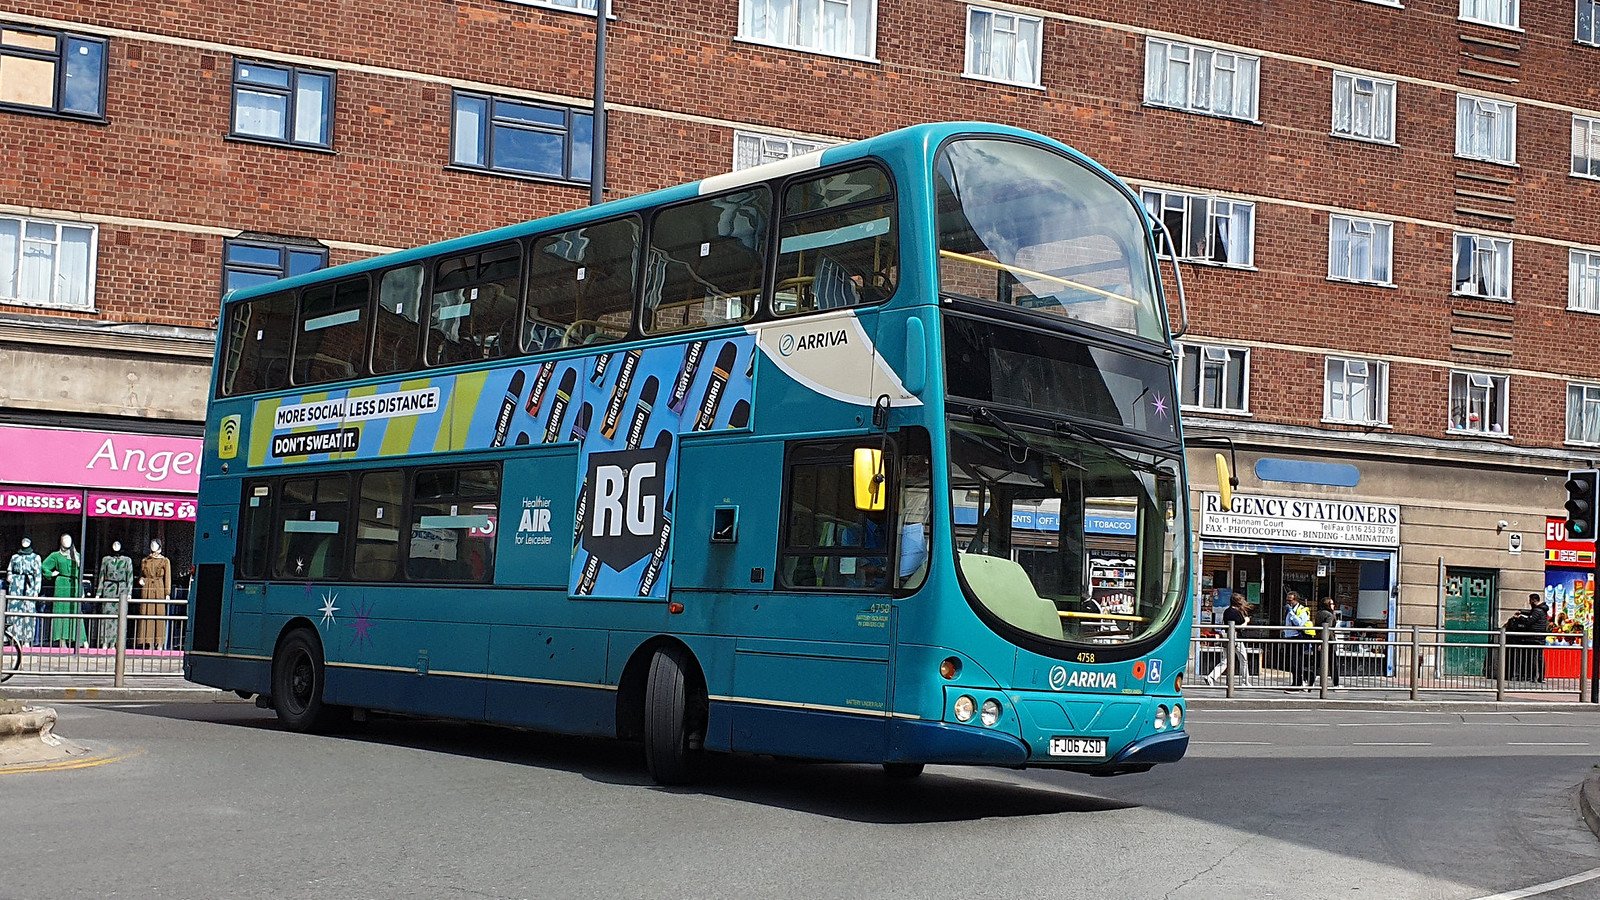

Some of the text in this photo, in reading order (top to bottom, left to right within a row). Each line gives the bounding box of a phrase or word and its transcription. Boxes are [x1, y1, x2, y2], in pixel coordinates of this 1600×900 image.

[797, 329, 848, 351] ARRIVA
[532, 376, 545, 404] RIGHT
[607, 356, 634, 425] RIGHT GUARD
[675, 371, 690, 399] RIGHT
[704, 380, 720, 414] GUARD
[277, 408, 306, 424] MORE
[349, 400, 375, 417] LESS
[378, 392, 437, 413] DISTANCE.
[498, 403, 512, 434] GUARD
[549, 402, 563, 434] GUARD
[630, 412, 645, 446] GUARD
[275, 432, 355, 453] DON'T SWEAT IT.
[7, 494, 64, 509] DRESSES
[66, 498, 81, 510] £6
[95, 498, 196, 519] SCARVES £2
[522, 496, 551, 508] Healthier
[592, 462, 656, 537] RG
[518, 508, 551, 532] AIR
[1038, 516, 1054, 525] OFF
[1231, 518, 1261, 526] Hannam
[1263, 519, 1284, 528] Court
[1292, 501, 1397, 524] STATIONERS
[1093, 520, 1132, 530] TOBACCO
[1205, 524, 1396, 544] FAX PHOTOCOPYING BINDING LAMINATING
[1364, 525, 1376, 534] 253
[1546, 522, 1565, 541] EU
[515, 532, 552, 545] for Leicester
[641, 524, 671, 595] RIGHT GUARD
[870, 603, 890, 614] 4758
[1076, 652, 1095, 663] 4758
[1067, 671, 1117, 689] ARRIVA
[1053, 739, 1102, 754] FJ06 ZSD
